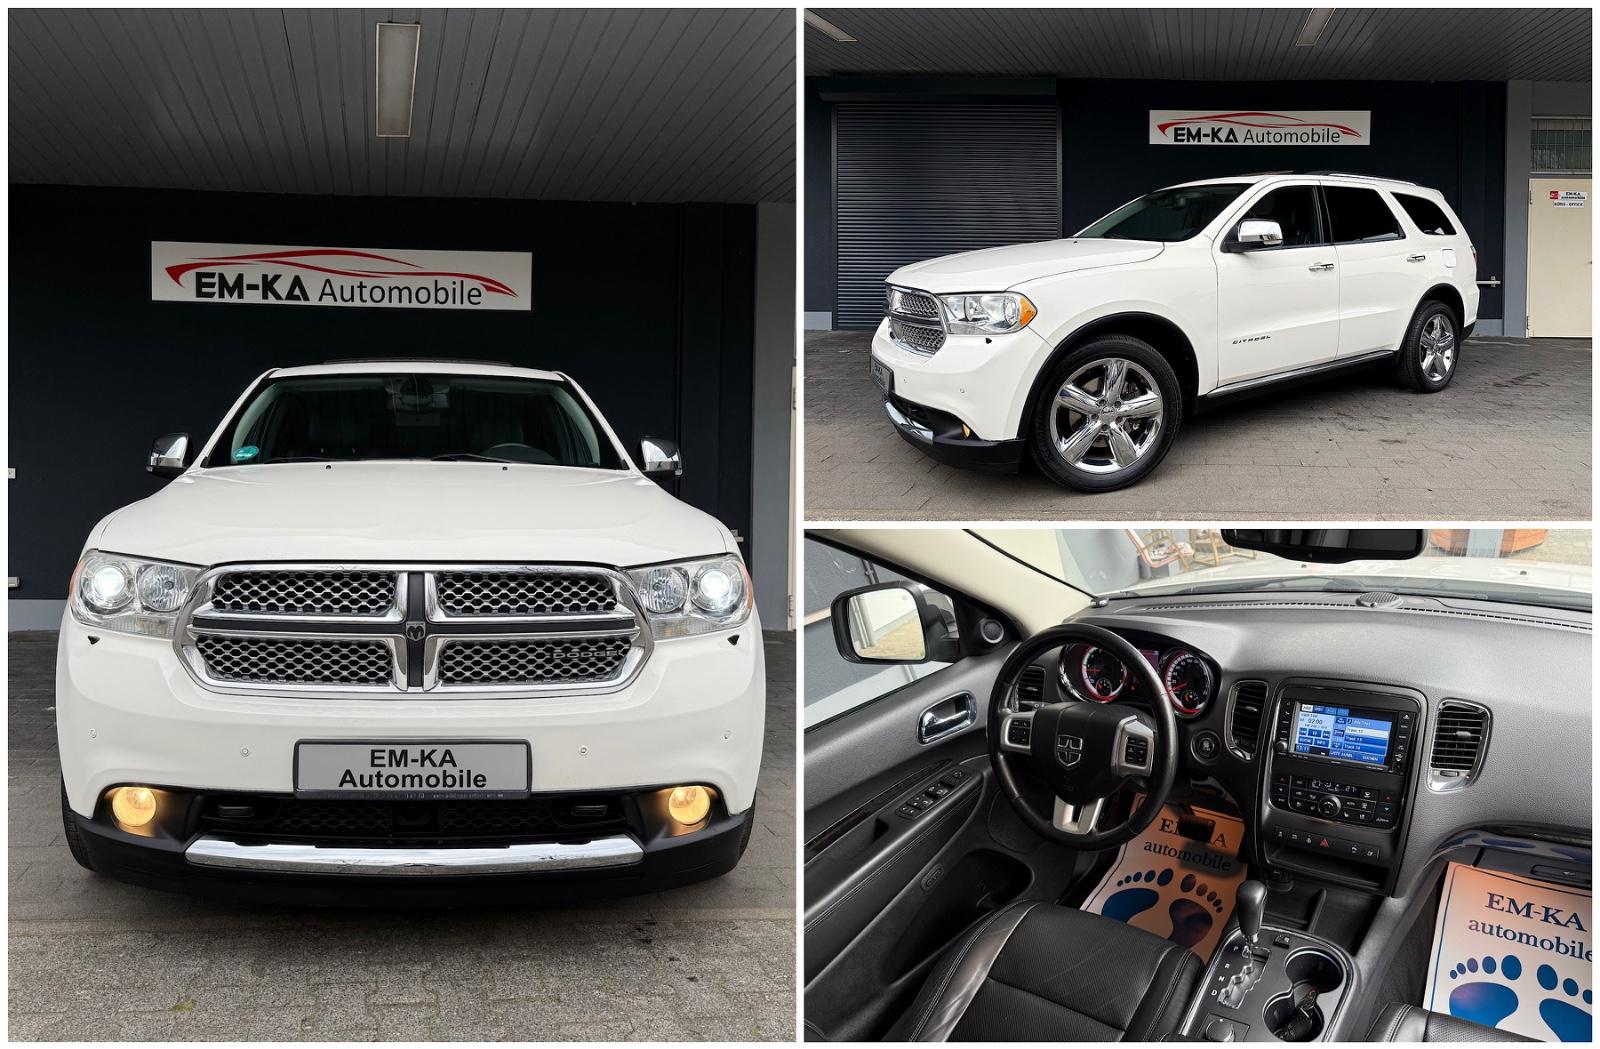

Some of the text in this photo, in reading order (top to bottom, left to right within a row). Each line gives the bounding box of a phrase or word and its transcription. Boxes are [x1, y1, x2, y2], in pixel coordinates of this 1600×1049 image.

[1173, 127, 1340, 144] EM-KA Automobile
[195, 271, 483, 305] EM-KA Automobile
[553, 650, 618, 659] DODGE
[370, 748, 457, 767] EM-KA
[338, 769, 487, 788] Automobile
[1143, 840, 1232, 872] automobile
[1485, 891, 1588, 932] EM-KA
